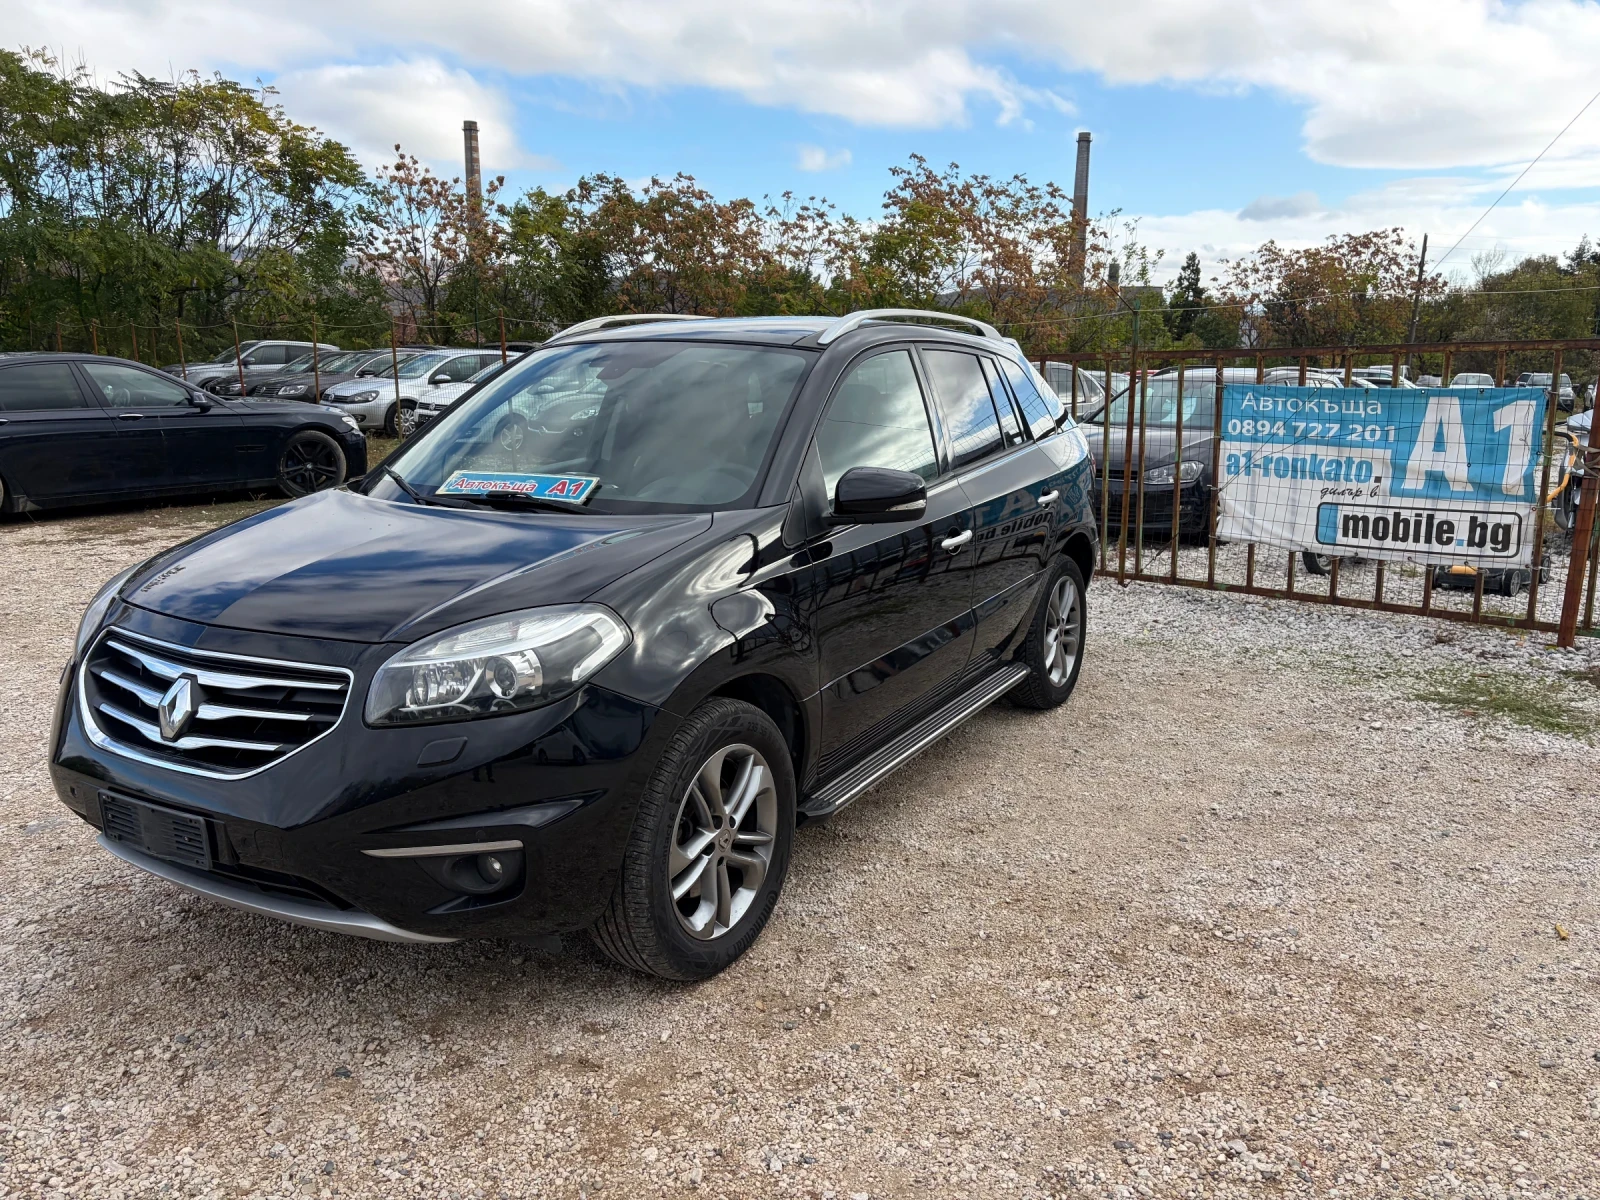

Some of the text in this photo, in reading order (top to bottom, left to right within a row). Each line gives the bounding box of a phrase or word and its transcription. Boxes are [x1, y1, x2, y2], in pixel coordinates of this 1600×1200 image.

[1241, 392, 1382, 417] Автокъща
[1227, 418, 1395, 443] 0894 727 201
[1401, 396, 1536, 496] A1
[452, 478, 585, 496] Автокъща A1
[1341, 511, 1512, 551] mobile.bg
[732, 889, 778, 954] Continental
